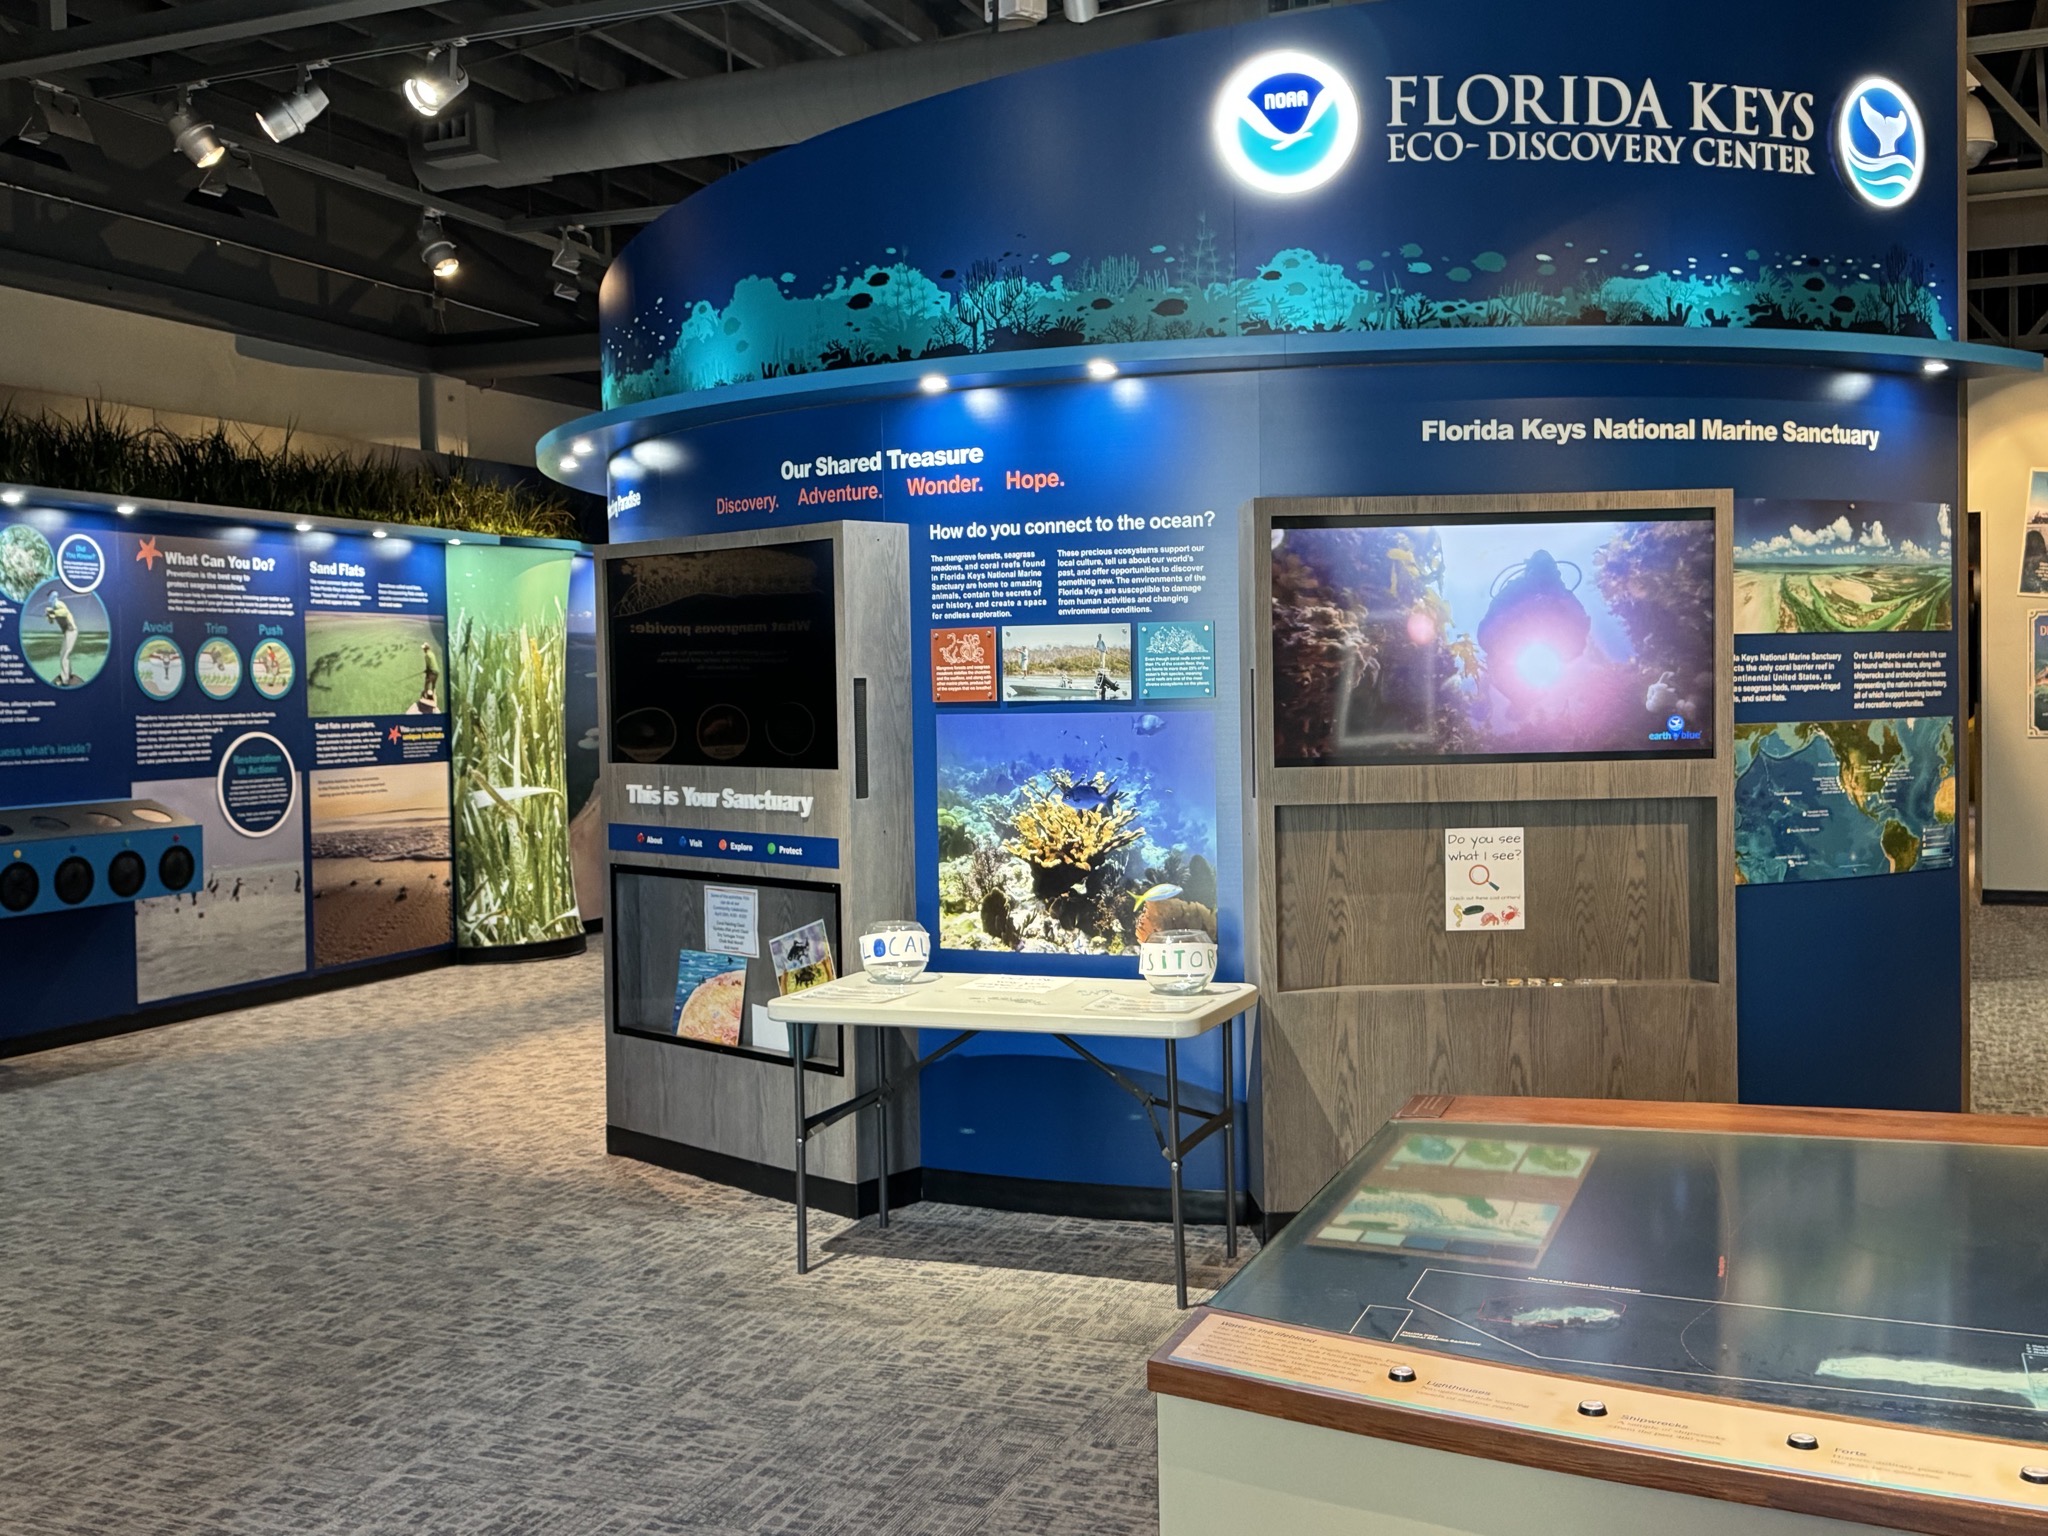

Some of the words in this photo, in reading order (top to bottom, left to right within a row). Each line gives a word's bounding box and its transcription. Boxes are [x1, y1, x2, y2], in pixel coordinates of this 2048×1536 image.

[1264, 89, 1308, 110] NOAA
[1385, 74, 1672, 129] FLORIDA
[1688, 81, 1815, 141] KEYS
[1692, 137, 1815, 175] CENTER
[1422, 419, 1514, 441] Florida
[1522, 419, 1586, 444] Keys
[1594, 418, 1695, 439] National
[1702, 419, 1777, 441] Marine
[1783, 421, 1880, 450] Sanctuary
[781, 460, 812, 480] Our
[815, 451, 882, 476] Shared
[886, 447, 984, 471] Treasure
[716, 494, 779, 515] Discovery.
[797, 485, 883, 506] Adventure.
[907, 474, 984, 496] Wonder.
[1006, 470, 1065, 493] Hope.
[930, 524, 963, 540] How
[967, 522, 987, 538] do
[991, 523, 1020, 539] you
[1025, 517, 1092, 534] connect
[1096, 516, 1113, 531] to
[1117, 514, 1145, 530] the
[1149, 511, 1216, 529] ocean?
[1058, 549, 1079, 557] These
[1081, 548, 1112, 557] precious
[1114, 547, 1158, 555] ecosystems
[1160, 545, 1190, 554] support
[164, 551, 198, 565] What
[201, 554, 225, 568] Can
[227, 556, 250, 570] You
[252, 557, 276, 571] Do?
[944, 554, 976, 563] mangrove
[977, 552, 1002, 560] forests,
[1004, 552, 1035, 561] seagrass
[1058, 559, 1075, 567] local
[1076, 556, 1103, 566] culture,
[1105, 557, 1116, 565] tell
[1129, 556, 1150, 564] about
[309, 561, 337, 575] Sand
[339, 562, 366, 577] Flats
[965, 562, 978, 570] and
[980, 561, 999, 569] coral
[1001, 560, 1020, 568] reefs
[1022, 559, 1045, 567] found
[940, 573, 965, 581] Florida
[967, 572, 986, 581] Keys
[987, 570, 1016, 578] National
[1058, 569, 1075, 578] past,
[1077, 568, 1091, 576] and
[1092, 567, 1109, 575] offer
[1111, 566, 1160, 577] opportunities
[1171, 565, 1205, 576] discover
[932, 583, 965, 591] Sanctuary
[1010, 579, 1042, 588] amazing
[1058, 577, 1096, 586] something
[1116, 576, 1130, 584] The
[1131, 575, 1183, 583] environments
[1184, 574, 1193, 582] of
[932, 592, 961, 600] animals,
[963, 591, 990, 599] contain
[992, 590, 1004, 598] the
[1033, 588, 1041, 596] of
[1058, 588, 1083, 596] Florida
[1085, 587, 1103, 596] Keys
[1118, 585, 1160, 594] susceptible
[1171, 585, 1203, 593] damage
[975, 600, 989, 608] and
[1024, 599, 1047, 607] space
[1103, 596, 1136, 604] activities
[1137, 595, 1152, 603] and
[1153, 595, 1189, 604] changing
[932, 612, 942, 620] for
[971, 611, 1012, 619] exploration.
[1058, 607, 1110, 615] environmental
[1111, 606, 1152, 614] conditions.
[142, 621, 173, 634] Avoid
[204, 622, 228, 634] Trim
[258, 623, 283, 636] Push
[1741, 654, 1759, 663] Keys
[1760, 653, 1787, 661] National
[1789, 653, 1810, 661] Marine
[1811, 652, 1841, 661] Sanctuary
[1746, 664, 1757, 672] the
[1759, 664, 1773, 673] only
[1775, 663, 1792, 671] coral
[1793, 663, 1814, 671] barrier
[1815, 662, 1827, 670] reef
[1828, 662, 1834, 670] in
[1773, 673, 1796, 681] United
[1798, 673, 1822, 681] States,
[1743, 685, 1772, 693] seagrass
[1791, 682, 1840, 692] mangrove-fringed
[1742, 694, 1754, 702] and
[1755, 694, 1771, 702] sand
[1772, 693, 1786, 701] flats.
[1648, 731, 1672, 741] earth
[1681, 731, 1701, 740] blue
[626, 784, 661, 805] This
[663, 785, 679, 806] is
[682, 786, 720, 807] Your
[722, 787, 814, 818] Sanctuary
[646, 835, 663, 845] About
[689, 838, 703, 848] Visit
[1448, 834, 1465, 844] Do
[1470, 836, 1493, 849] you
[1498, 835, 1521, 844] see
[730, 842, 753, 852] Explore
[779, 845, 802, 855] Protect
[1448, 850, 1479, 861] what
[1492, 849, 1522, 861] see?
[862, 936, 927, 959] LOCAL
